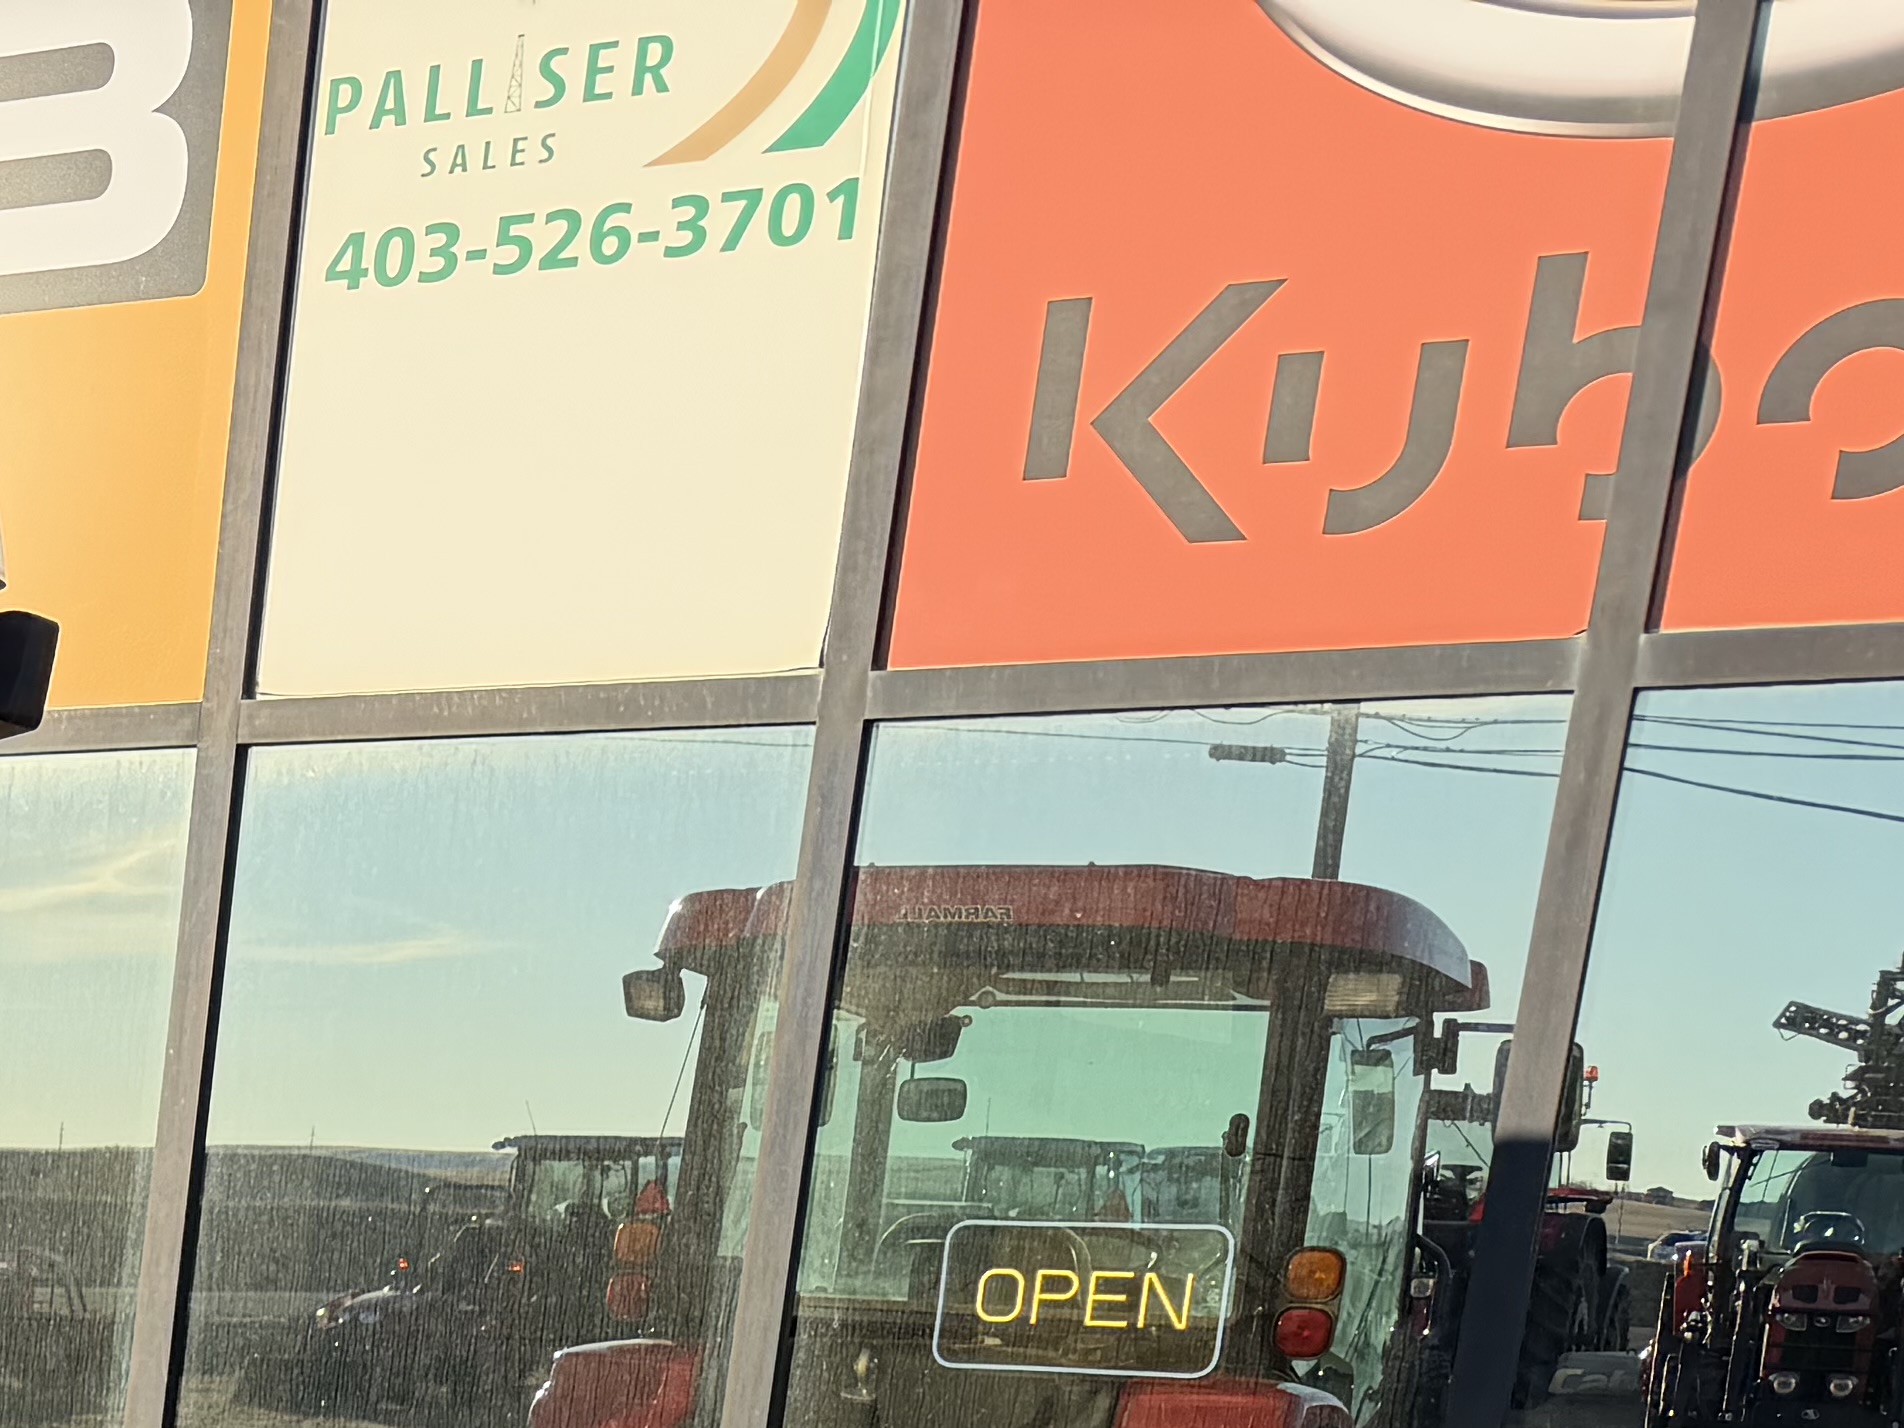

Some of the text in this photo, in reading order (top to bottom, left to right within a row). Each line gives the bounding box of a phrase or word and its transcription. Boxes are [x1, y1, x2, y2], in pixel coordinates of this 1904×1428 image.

[324, 34, 674, 136] PALLISER
[420, 133, 556, 178] SALES
[324, 178, 860, 291] 403-526-3701
[976, 1268, 1194, 1330] OPEN
